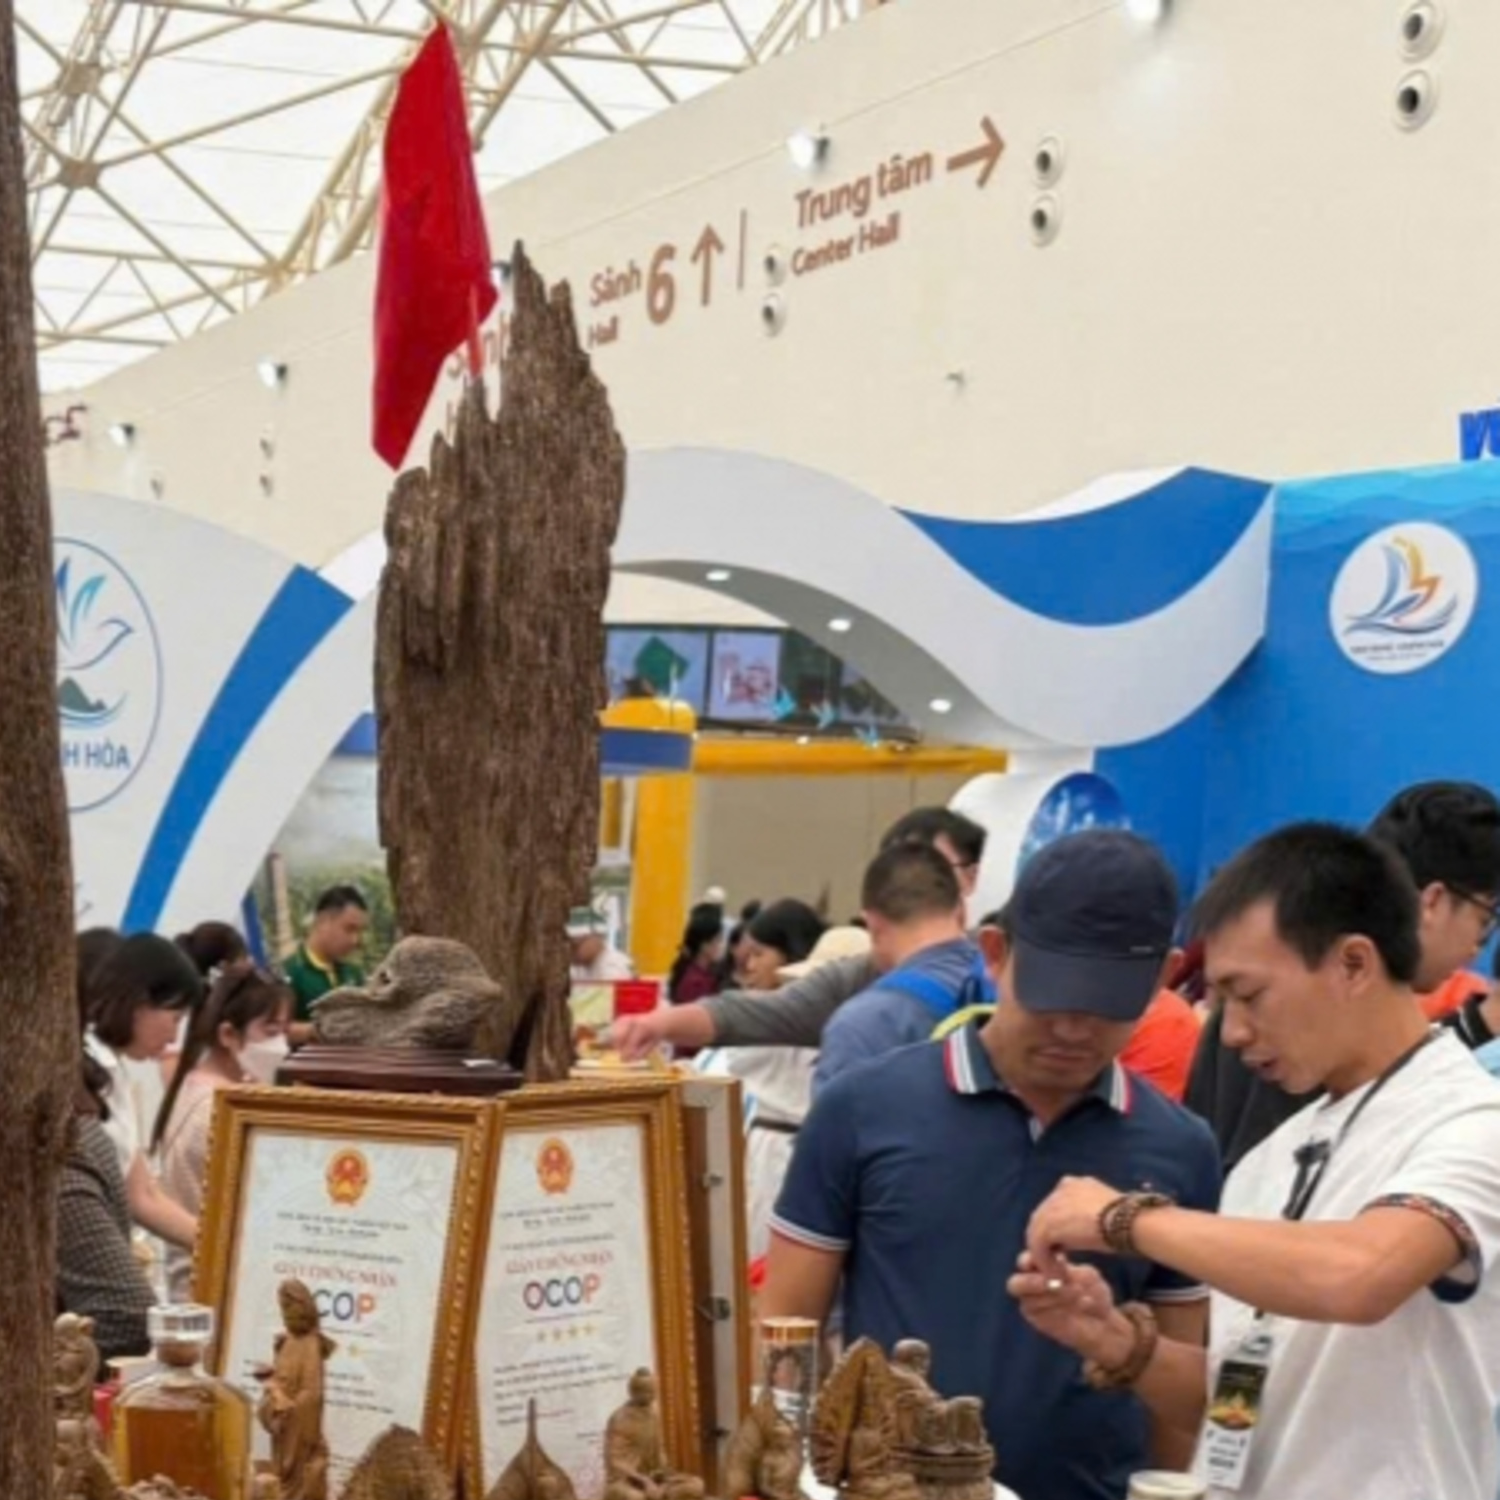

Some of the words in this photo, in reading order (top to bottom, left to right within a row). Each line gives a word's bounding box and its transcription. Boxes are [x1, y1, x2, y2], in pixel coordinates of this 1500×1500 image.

[795, 176, 871, 229] Trung
[877, 152, 932, 198] tâm
[791, 234, 853, 276] Center
[858, 213, 900, 256] Hall
[647, 243, 676, 325] 6
[588, 316, 618, 348] Hall
[85, 737, 131, 769] HÒA
[312, 1289, 376, 1322] COP
[523, 1273, 600, 1311] OCOP
